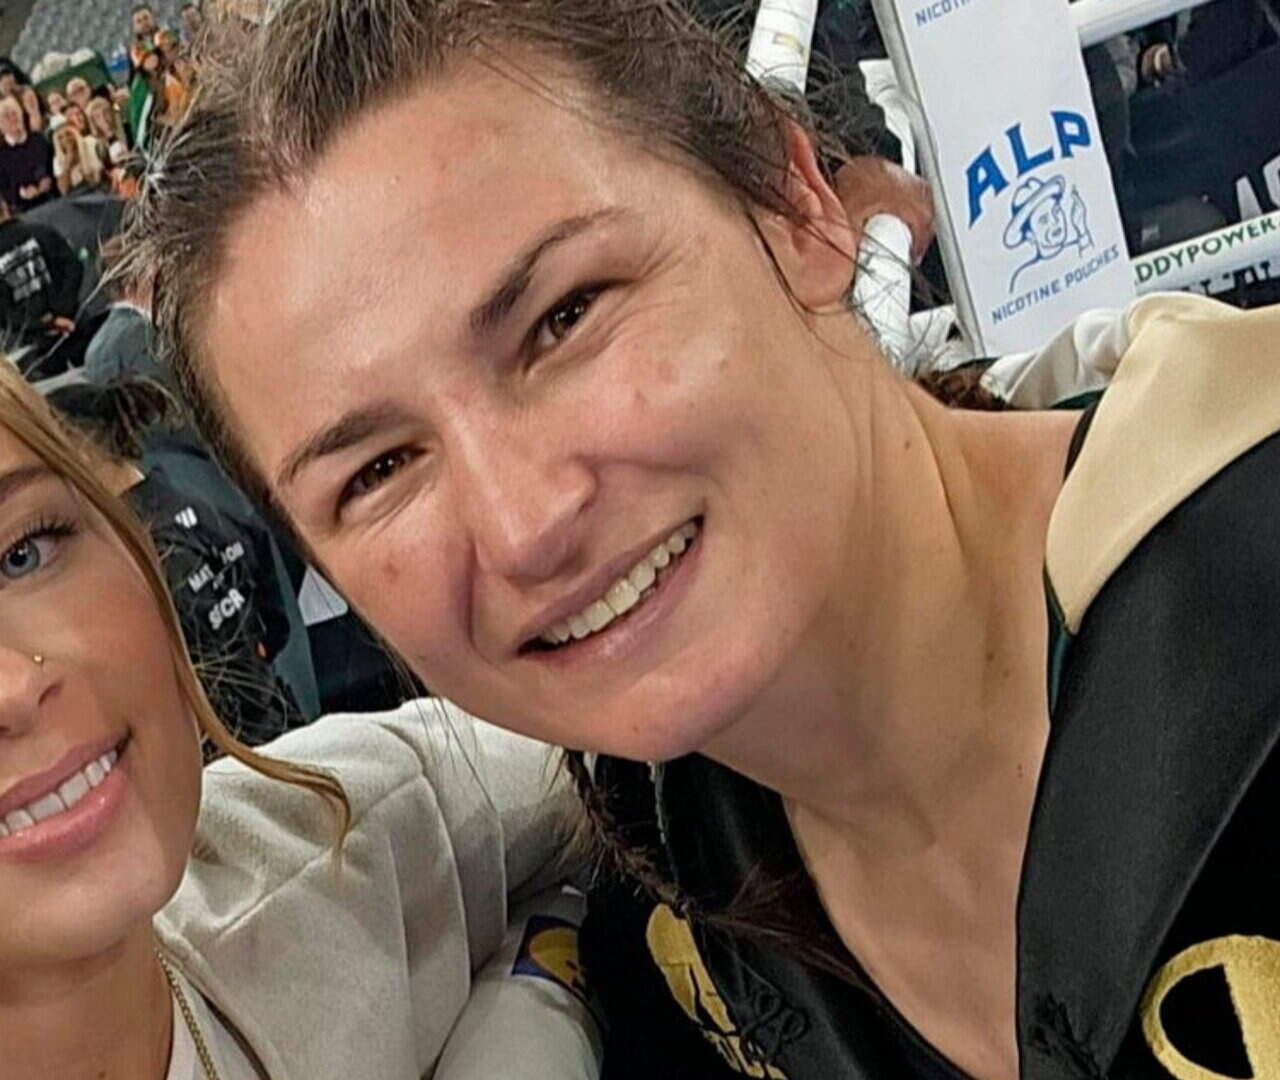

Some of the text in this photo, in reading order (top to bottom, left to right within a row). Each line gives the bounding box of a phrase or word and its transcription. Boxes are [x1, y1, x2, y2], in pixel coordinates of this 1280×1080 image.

[965, 110, 1092, 230] ALP
[991, 244, 1120, 325] NICOTINE POUCHES
